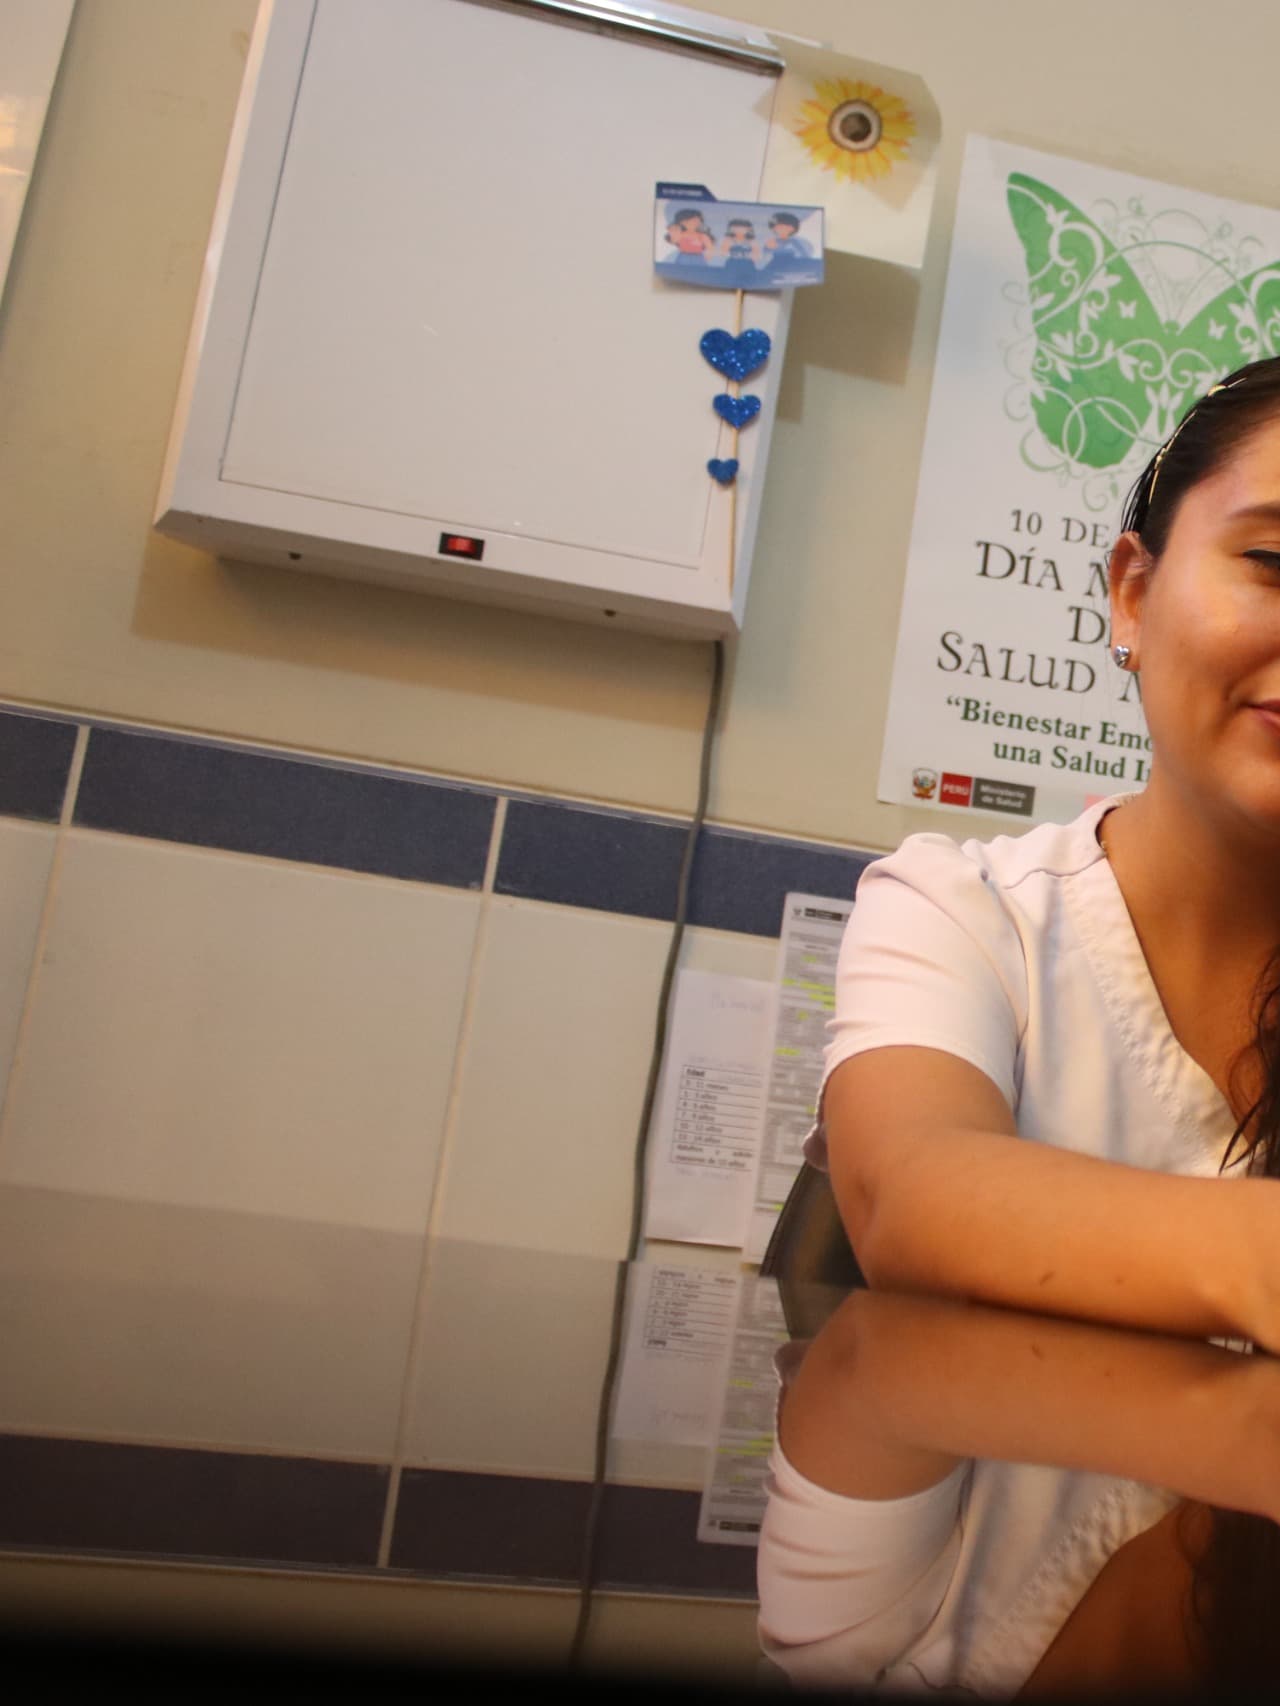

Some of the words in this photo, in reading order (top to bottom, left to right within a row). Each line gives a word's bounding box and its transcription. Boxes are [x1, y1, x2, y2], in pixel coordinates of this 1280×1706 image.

[1011, 508, 1042, 536] 10
[1061, 516, 1110, 549] DE
[975, 540, 1064, 591] DÍA
[937, 630, 1096, 694] SALUD
[993, 741, 1041, 766] una
[1050, 744, 1126, 779] Salud
